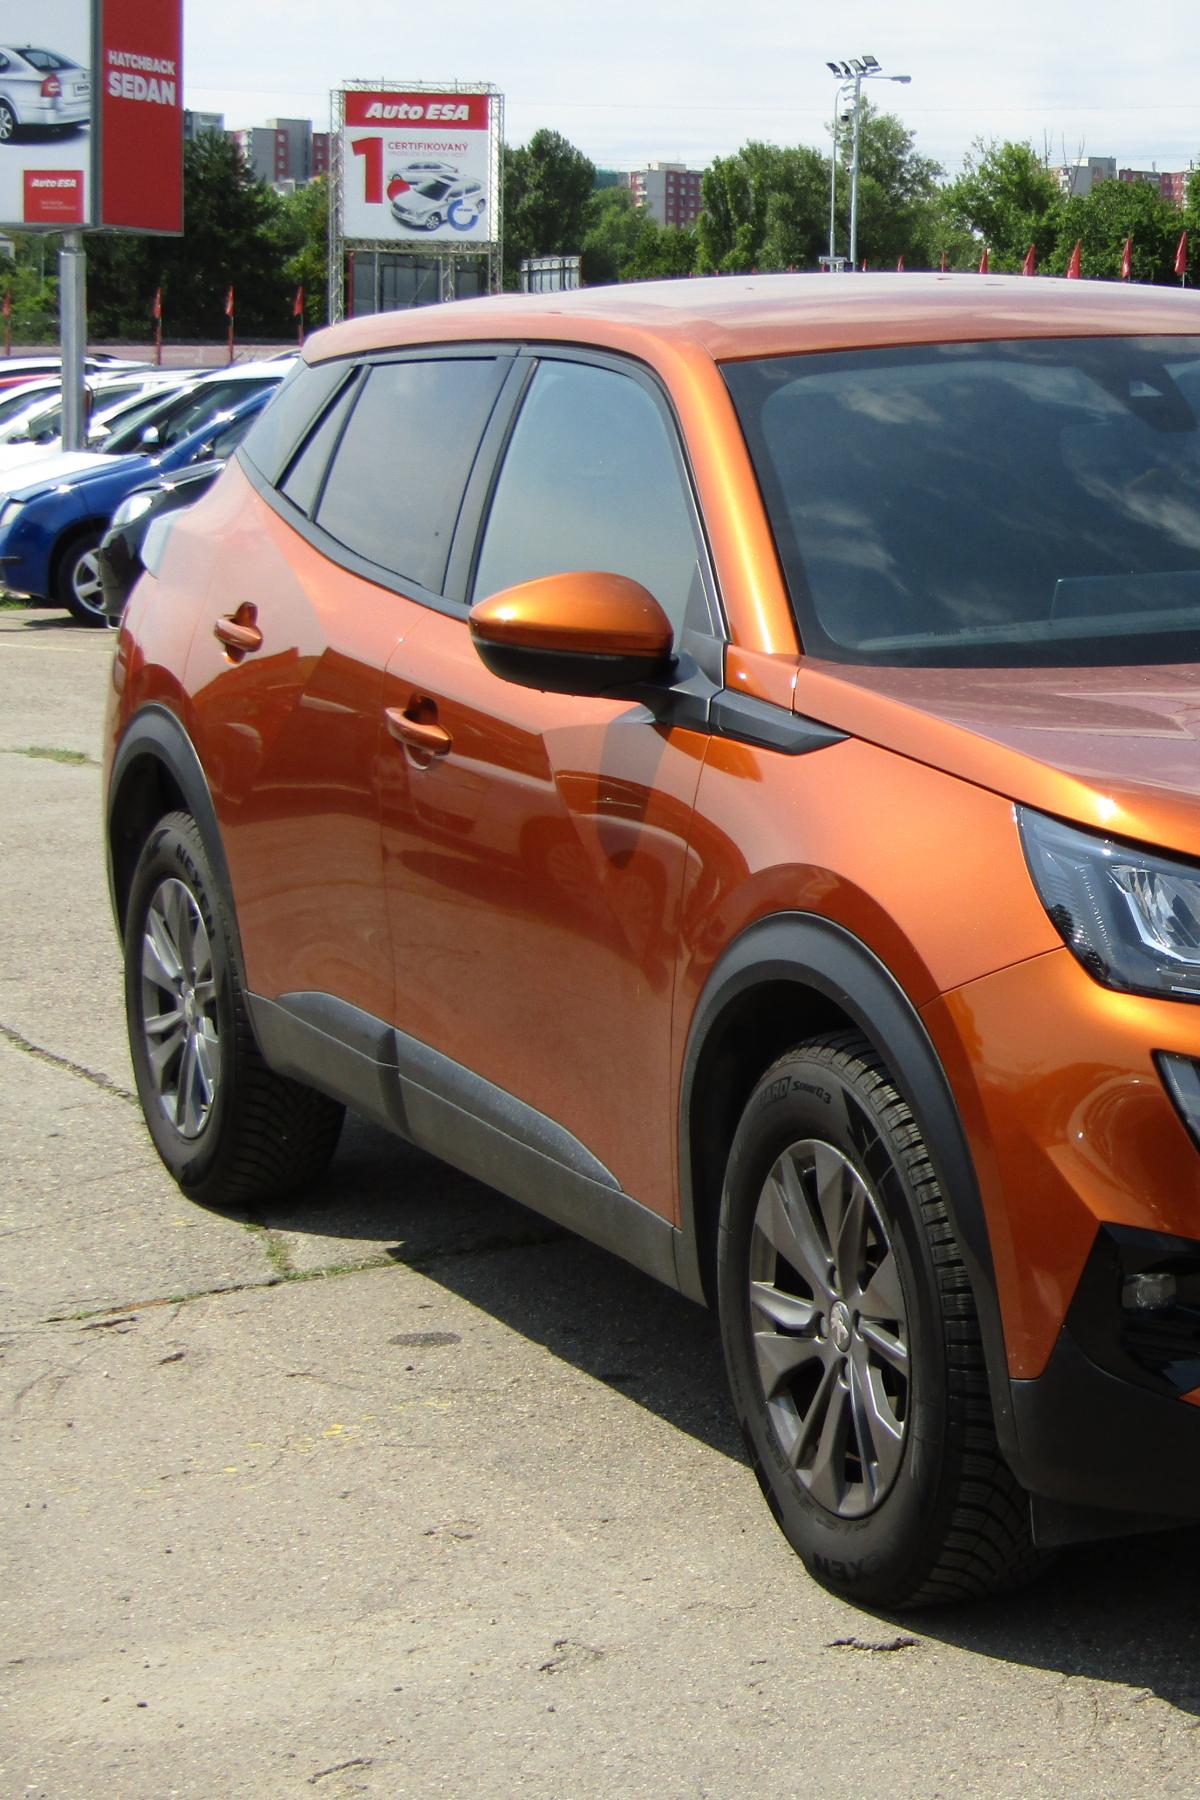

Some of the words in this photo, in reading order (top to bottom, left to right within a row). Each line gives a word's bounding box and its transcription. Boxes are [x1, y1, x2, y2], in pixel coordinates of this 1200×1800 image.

[108, 50, 176, 76] HATCHBACK
[108, 71, 176, 106] SEDAN
[365, 102, 424, 120] Auto
[425, 103, 470, 121] ESA
[352, 137, 383, 204] 1
